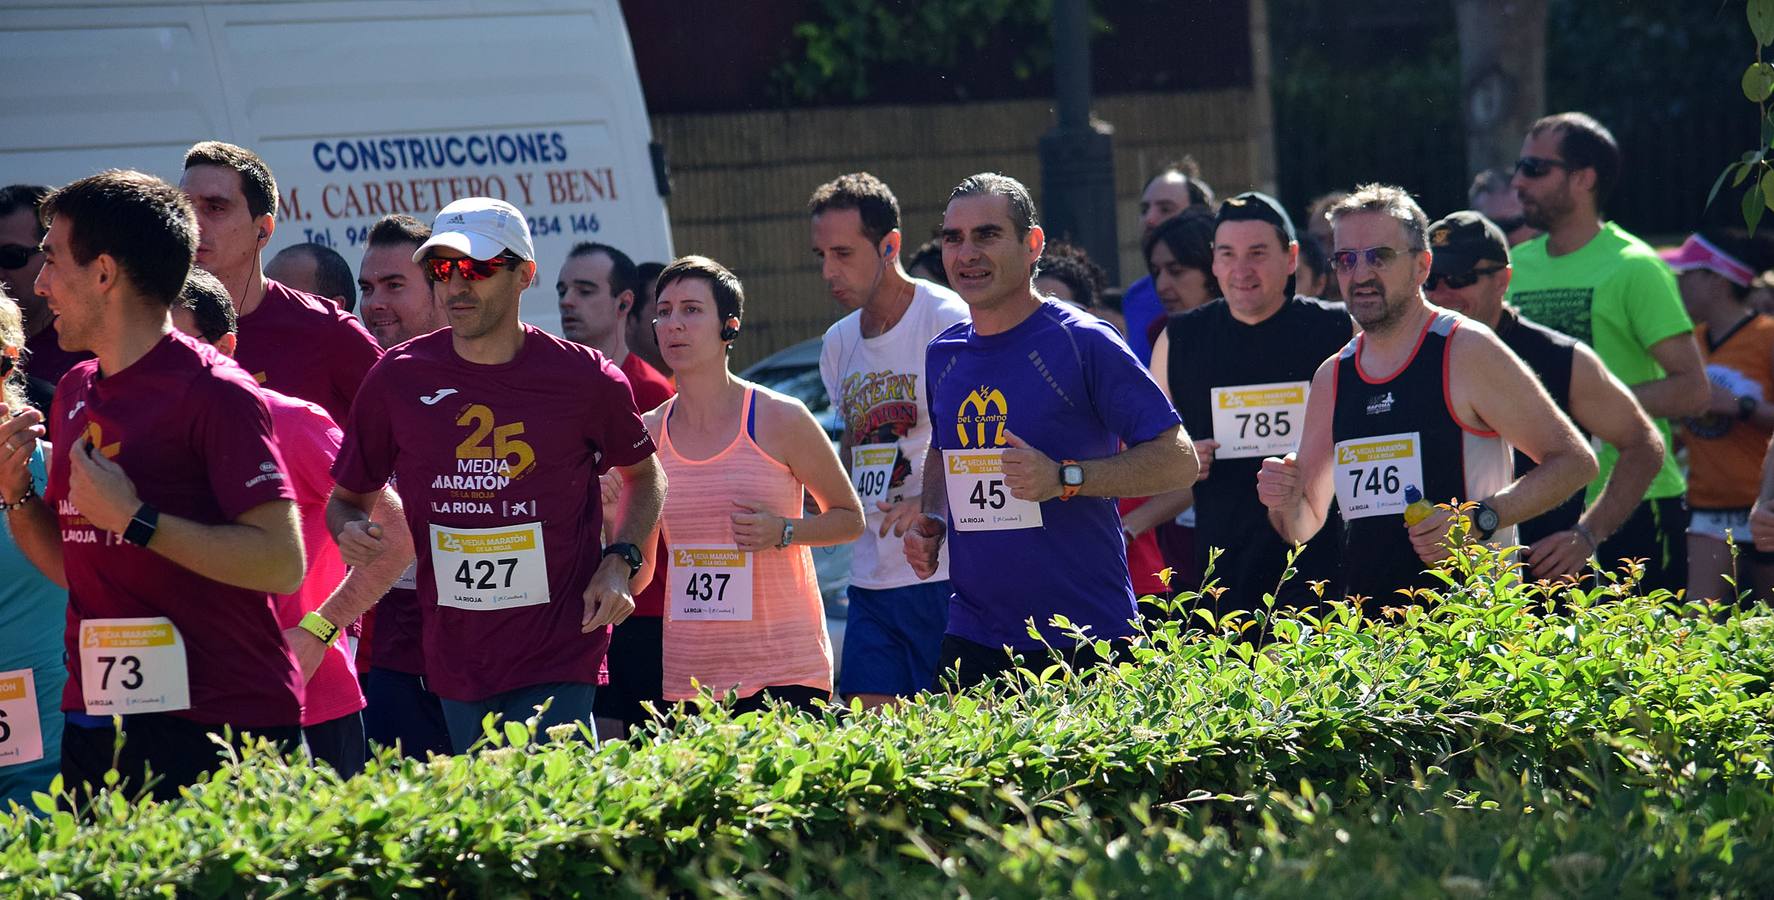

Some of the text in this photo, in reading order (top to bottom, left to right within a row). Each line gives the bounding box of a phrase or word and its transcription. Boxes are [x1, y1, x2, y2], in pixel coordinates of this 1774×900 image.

[313, 132, 567, 172] CONSTRUCCIONES
[322, 175, 507, 219] CARRETERO
[515, 172, 534, 206] Y
[545, 167, 619, 205] BENI
[304, 227, 337, 247] Tel.
[528, 216, 561, 237] 254
[570, 212, 600, 234] 146
[1235, 411, 1291, 439] 785
[456, 404, 536, 479] 25
[1342, 447, 1358, 464] 25
[457, 459, 511, 473] MEDIA
[952, 456, 969, 474] 25
[431, 472, 510, 490] MARATÓN
[471, 491, 496, 499] RIOJA
[857, 470, 886, 497] 409
[969, 480, 1006, 510] 45
[1348, 465, 1400, 498] 746
[432, 501, 494, 514] LA RIOJA
[443, 534, 527, 552] 25 MEDIA MARATÓN
[679, 550, 695, 567] 25
[455, 557, 518, 590] 427
[686, 572, 731, 601] 437
[97, 655, 143, 690] 73
